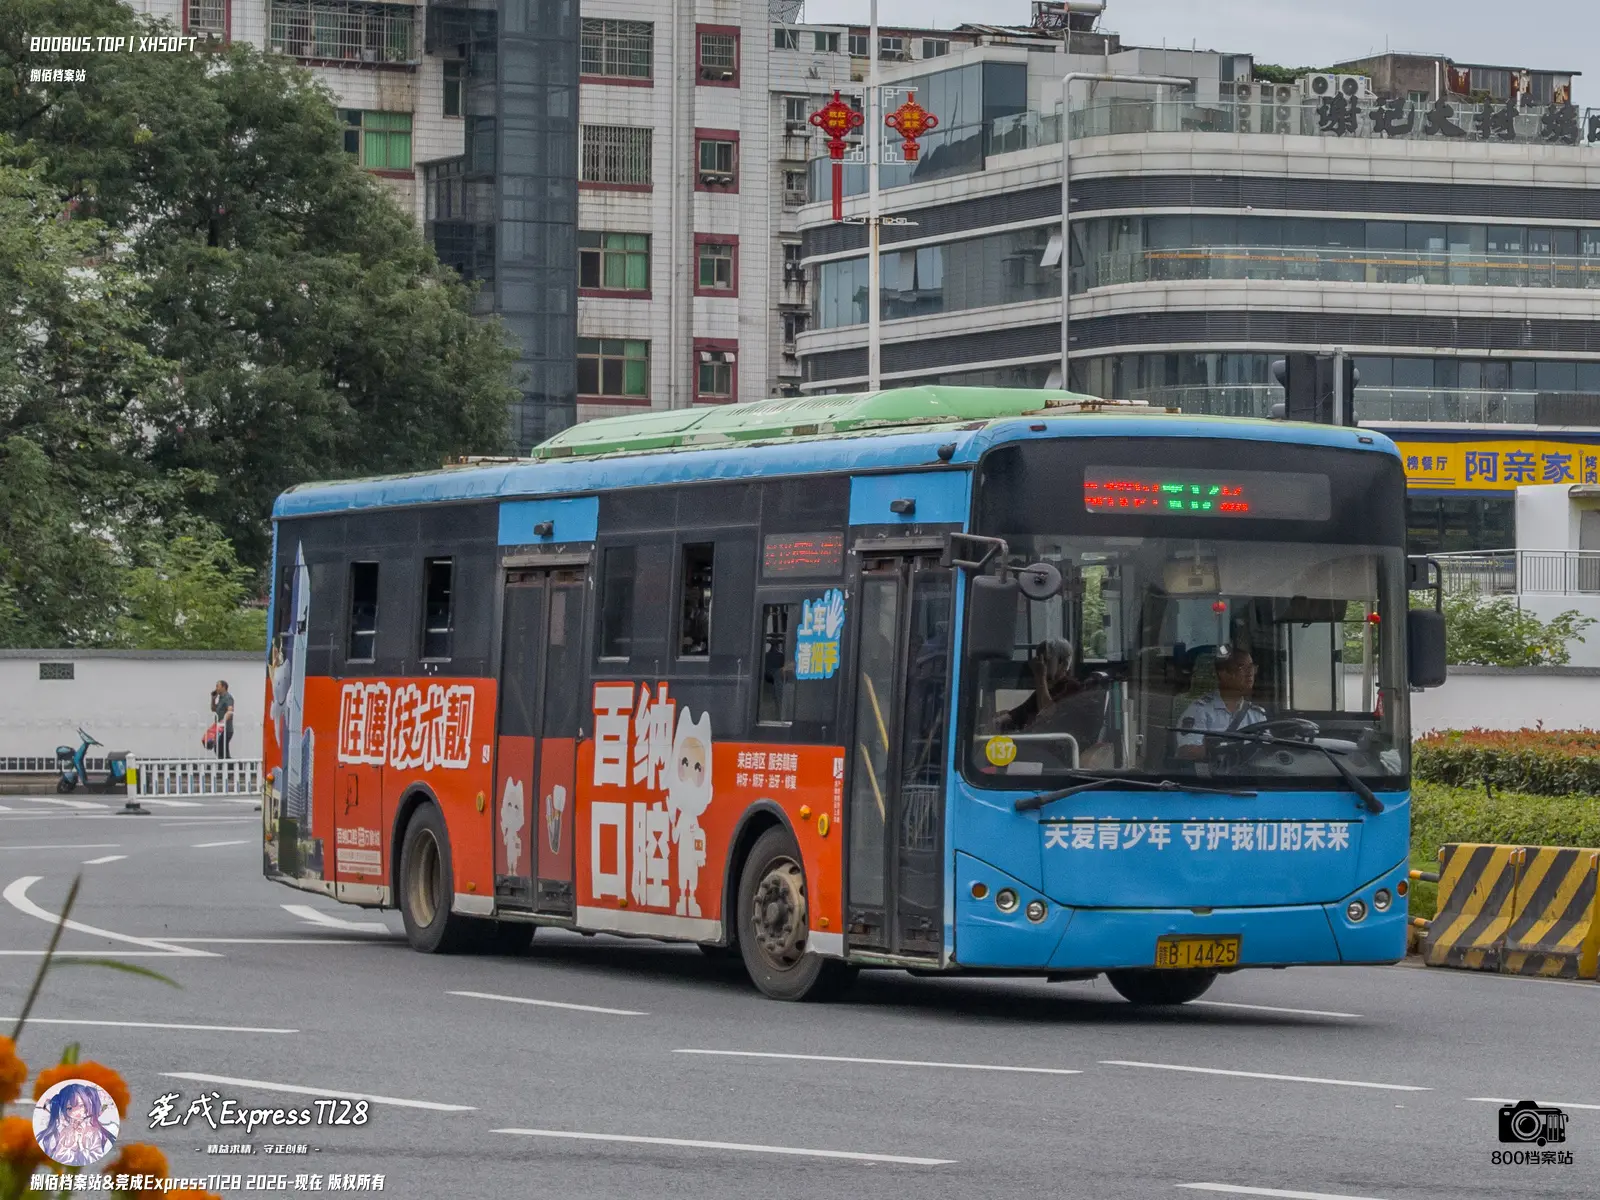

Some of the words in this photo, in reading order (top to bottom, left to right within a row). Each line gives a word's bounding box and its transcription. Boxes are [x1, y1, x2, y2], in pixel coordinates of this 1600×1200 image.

[1465, 449, 1574, 484] 阿亲家
[799, 604, 826, 636] 上车
[737, 751, 766, 769] 来自湾区
[989, 742, 1015, 760] 137
[1045, 816, 1171, 850] 关爱青少年
[1181, 817, 1350, 851] 守护我们的未来
[591, 801, 670, 908] 口腔
